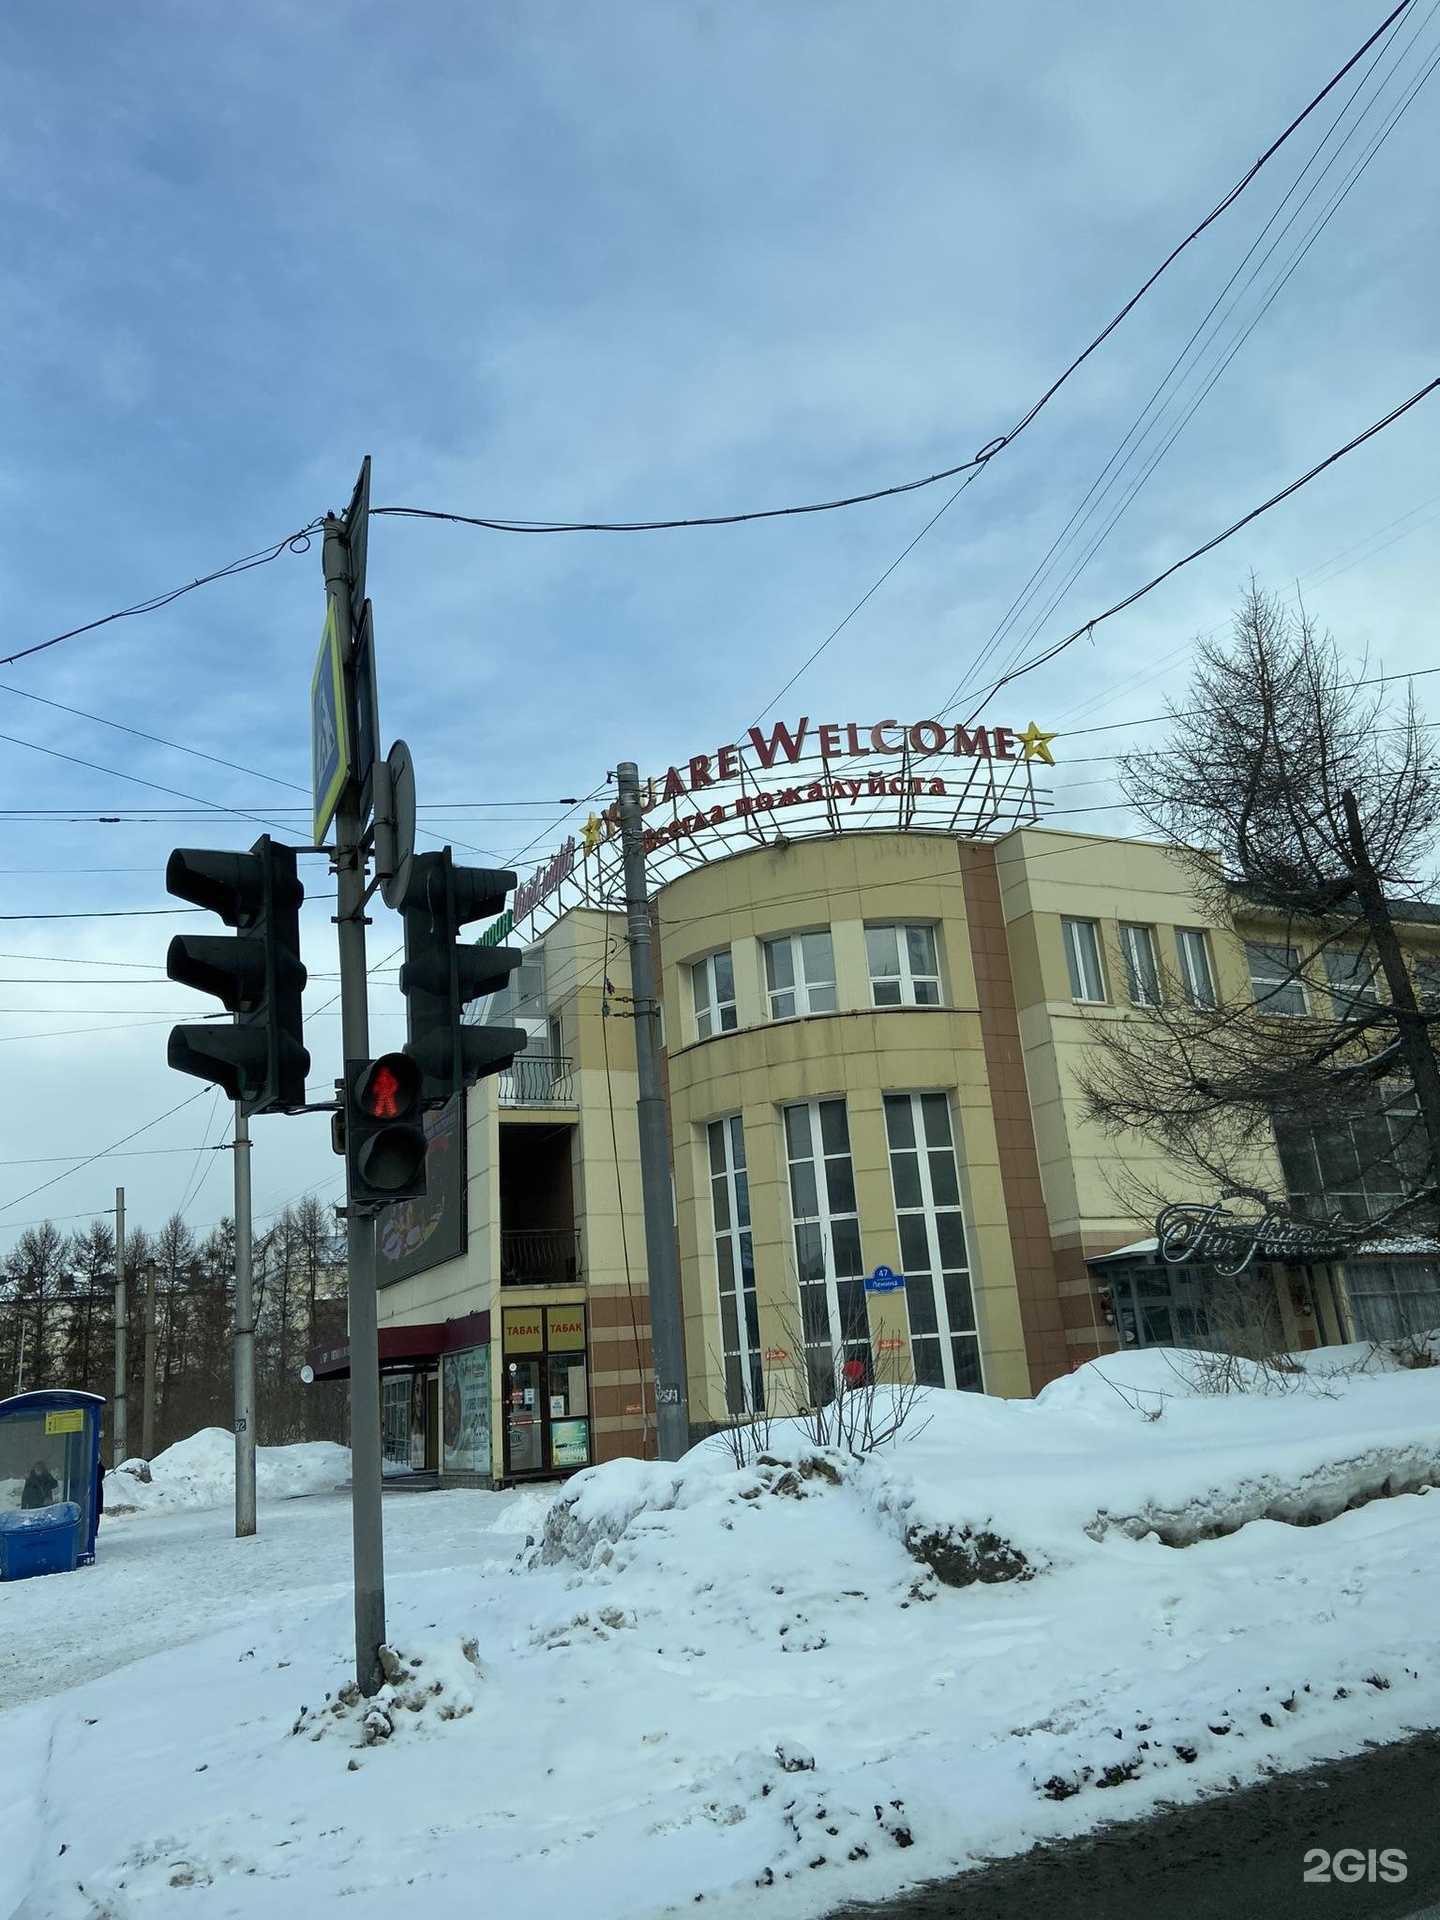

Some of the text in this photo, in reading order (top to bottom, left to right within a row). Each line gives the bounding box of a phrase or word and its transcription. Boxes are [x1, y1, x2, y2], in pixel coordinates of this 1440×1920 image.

[601, 716, 1016, 841] YU ARE WELCOME
[735, 771, 946, 816] пожалуйста
[877, 1269, 889, 1278] 47
[872, 1279, 899, 1290] Ленина
[506, 1322, 582, 1337] ТАБАК ТАБАК
